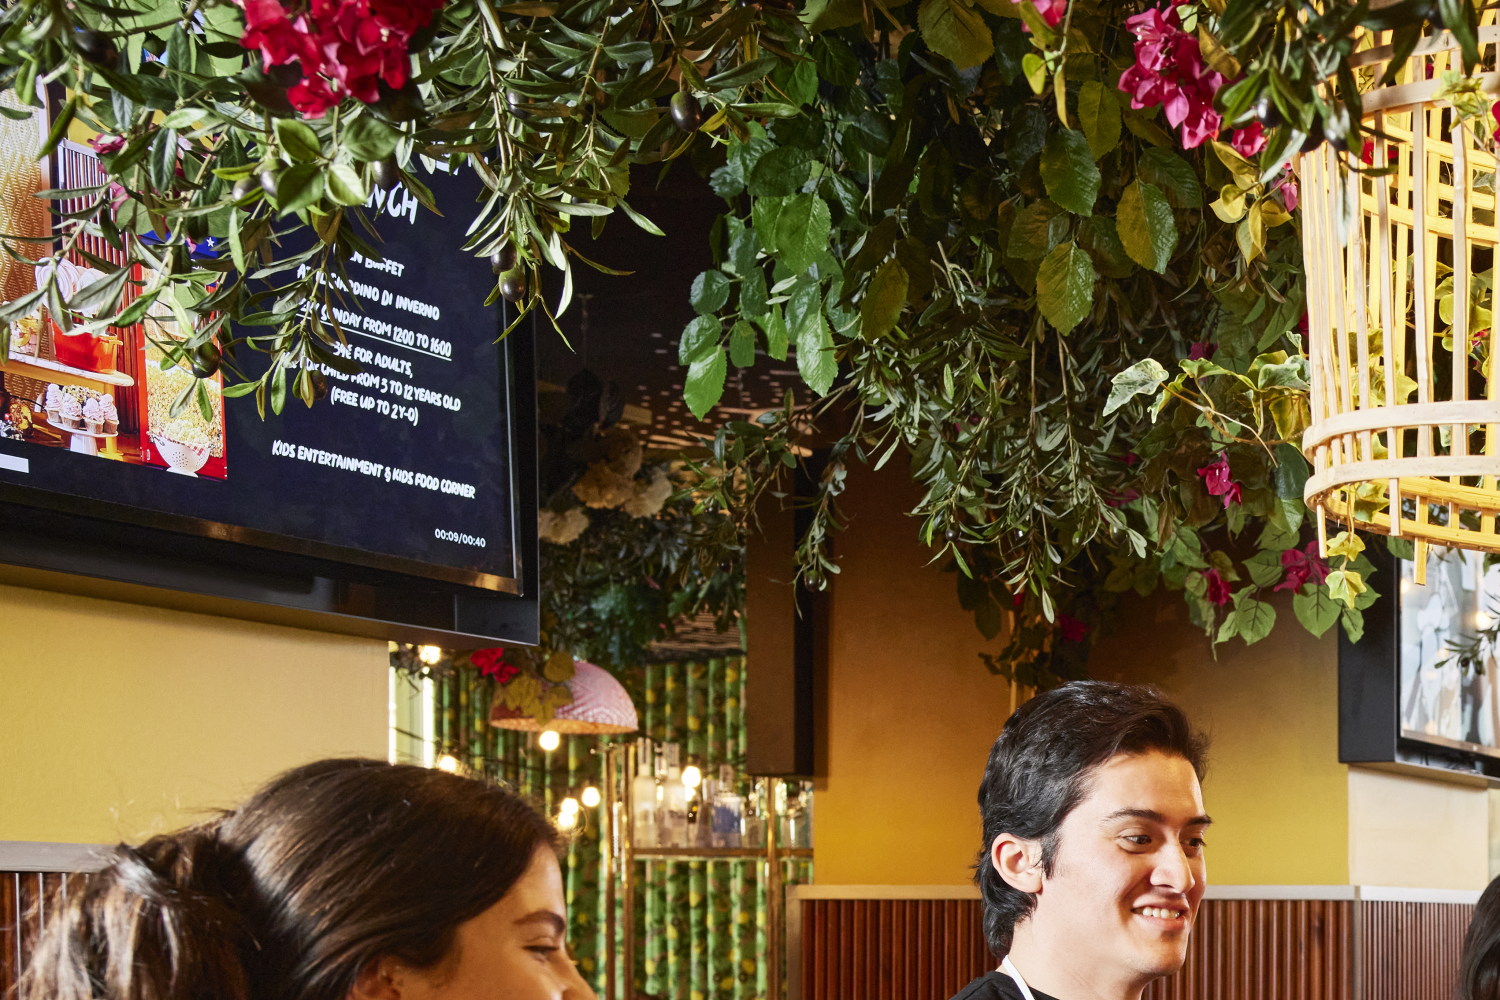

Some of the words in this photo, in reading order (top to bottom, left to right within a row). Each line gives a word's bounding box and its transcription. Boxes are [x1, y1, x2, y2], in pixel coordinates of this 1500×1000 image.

[381, 290, 393, 307] DI
[395, 295, 440, 321] INVERNO
[363, 317, 392, 337] FROM
[416, 333, 429, 350] TO
[353, 347, 373, 365] FOR
[374, 352, 413, 378] ADULTS,
[330, 386, 359, 407] (FREE
[360, 394, 375, 411] UP
[376, 399, 390, 415] TO
[351, 372, 379, 389] FROM
[380, 377, 389, 393] 3
[389, 380, 403, 396] TO
[403, 384, 414, 400] 12
[414, 388, 442, 408] YEARS
[442, 396, 462, 412] OLD
[272, 439, 296, 459] KIDS
[297, 445, 384, 478] ENTERTAINMENT
[392, 467, 414, 485] KIDS
[415, 473, 439, 491] FOOD
[440, 479, 476, 499] CORNER
[434, 527, 486, 548] 00:09/00:40
